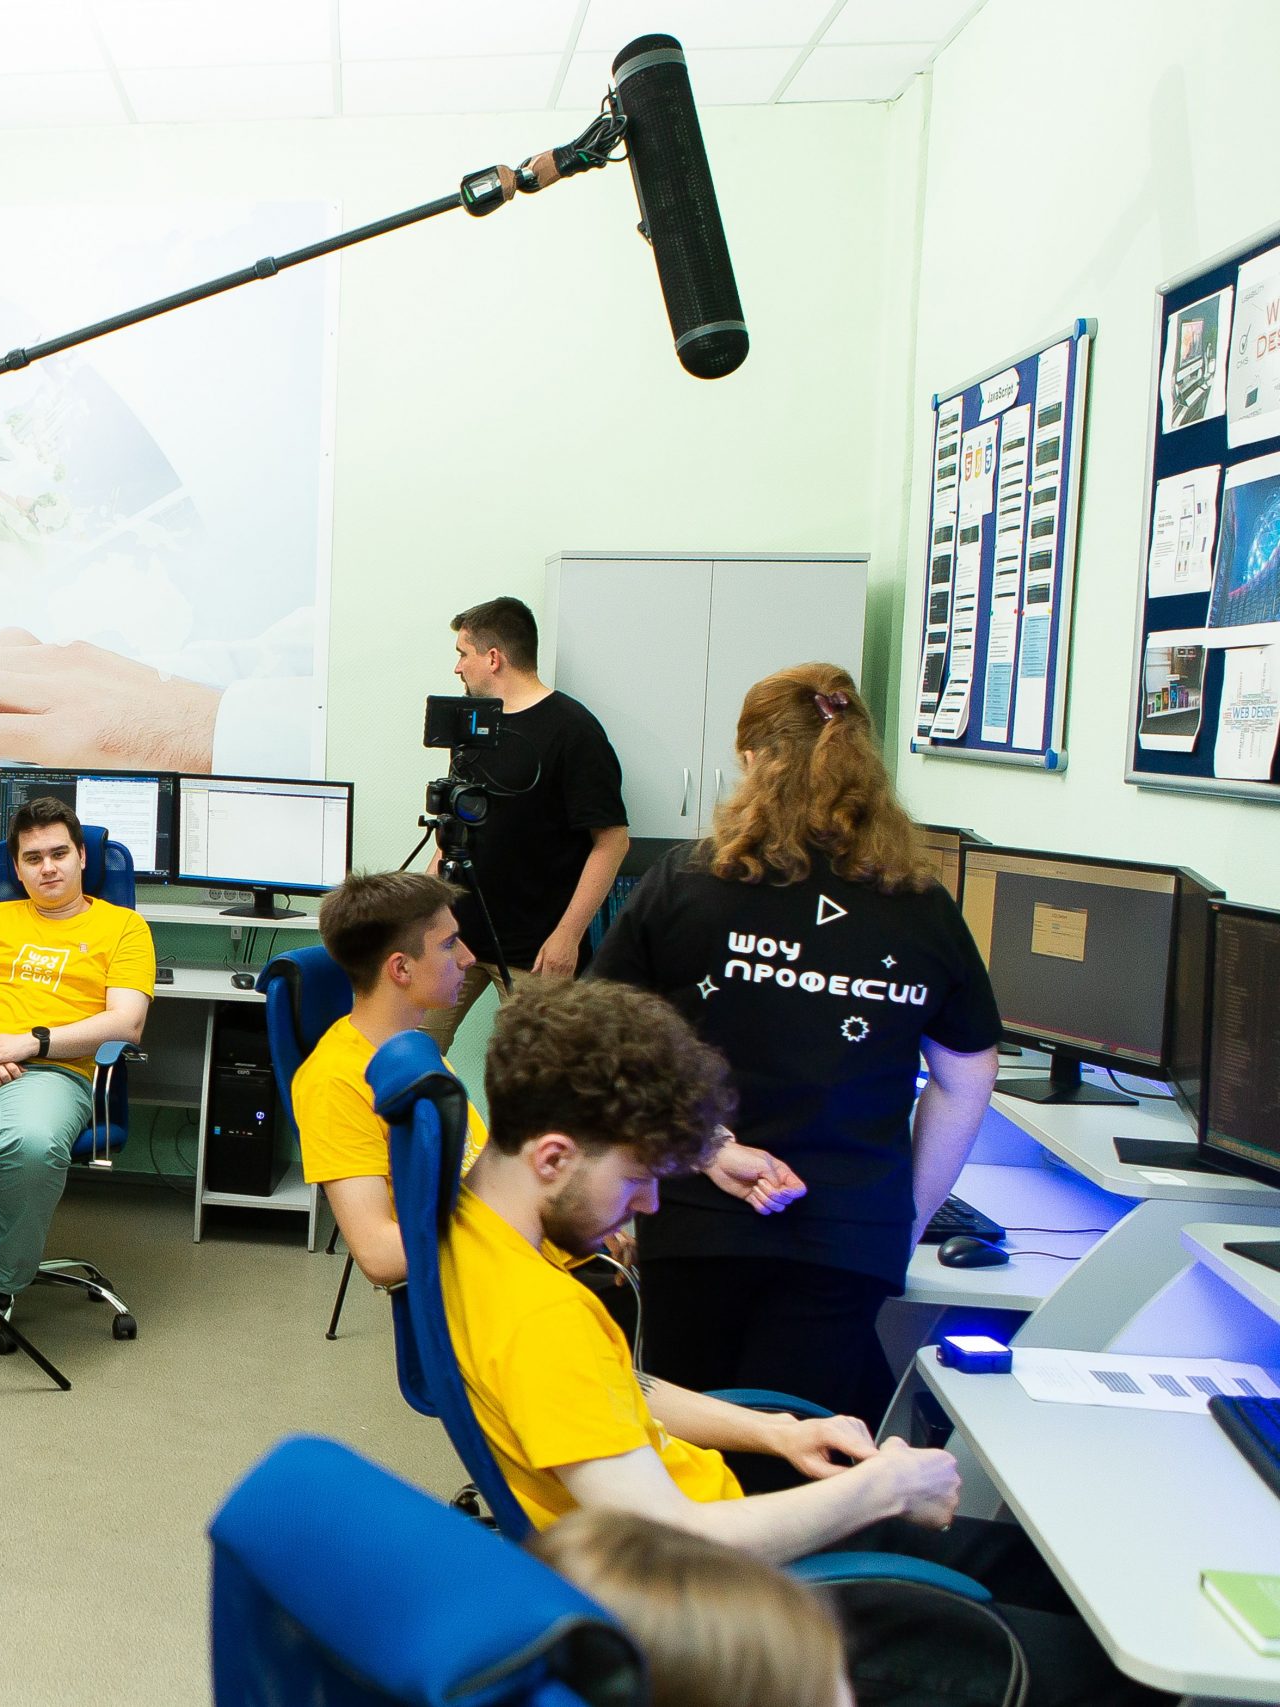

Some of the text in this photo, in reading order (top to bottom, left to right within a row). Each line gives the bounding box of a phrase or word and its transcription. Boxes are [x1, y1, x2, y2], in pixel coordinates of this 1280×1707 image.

[1233, 706, 1274, 719] WEB DESIGN
[728, 931, 801, 961] ШОУ
[724, 959, 928, 1006] ПРОФЕССИЙ
